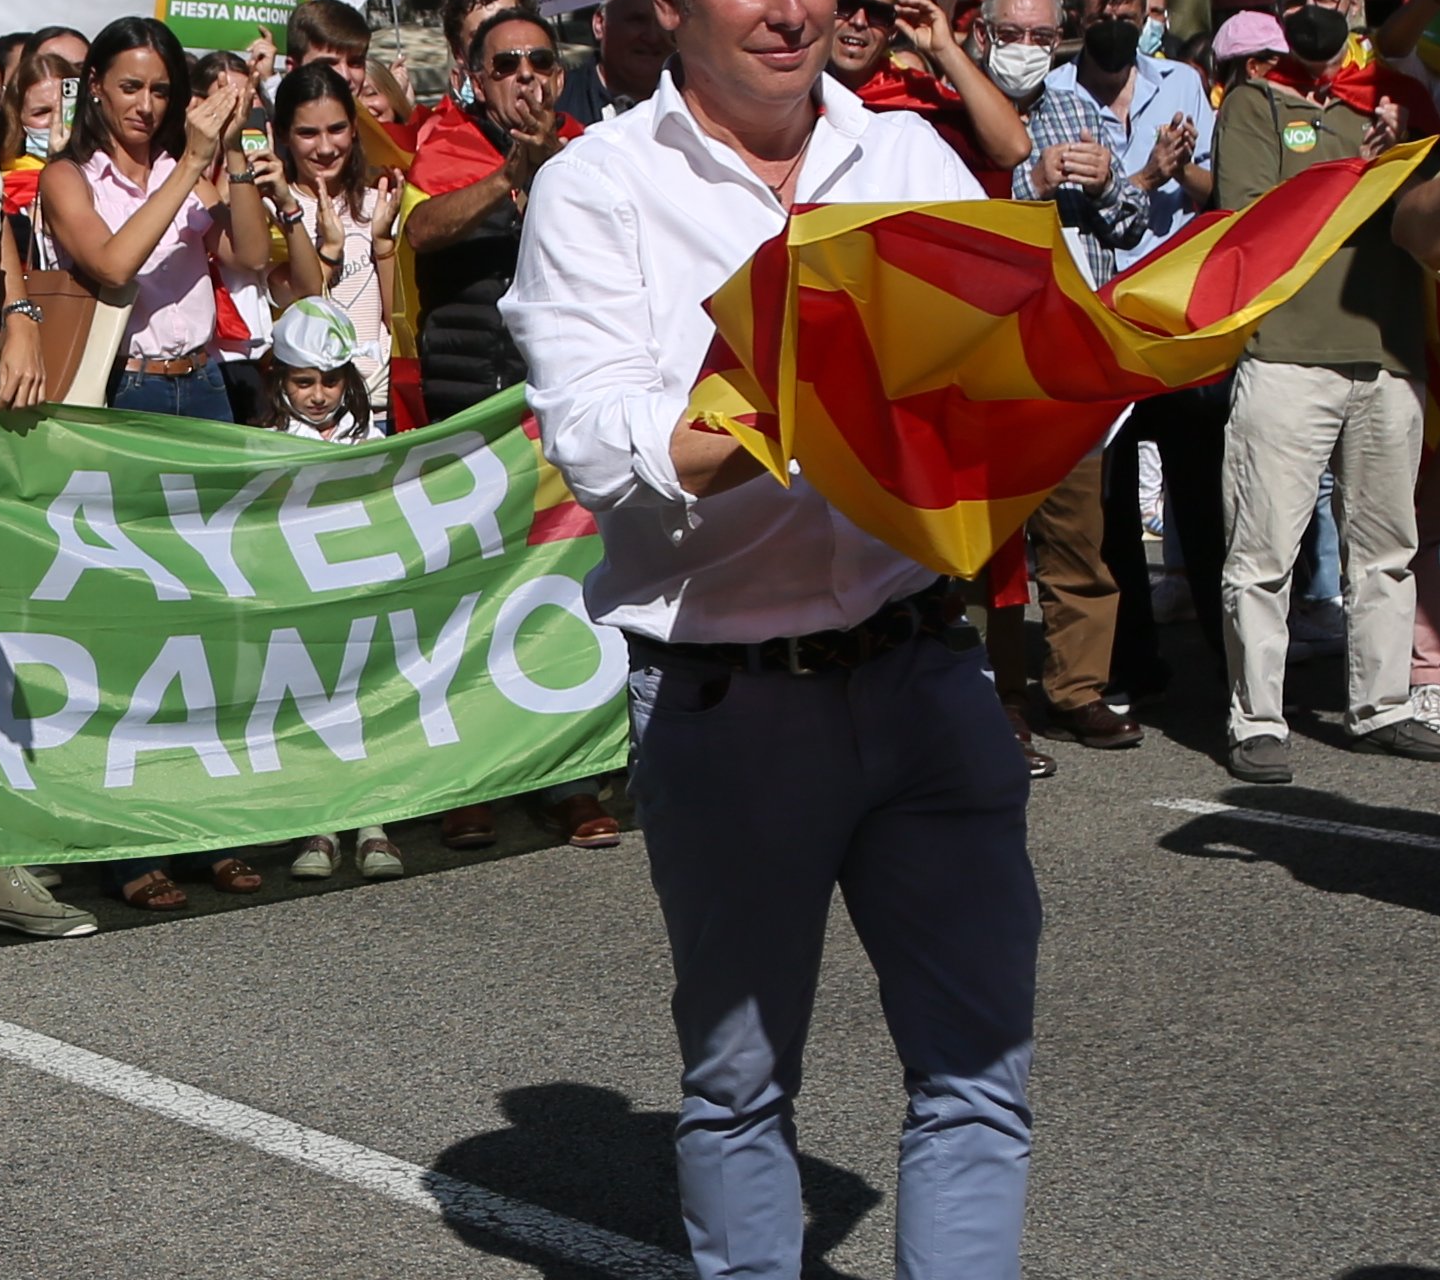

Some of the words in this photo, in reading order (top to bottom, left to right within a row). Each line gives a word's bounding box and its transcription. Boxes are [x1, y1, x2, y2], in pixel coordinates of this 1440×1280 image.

[170, 1, 229, 20] FIESTA
[1284, 129, 1316, 145] VOX
[29, 430, 509, 601] AYER
